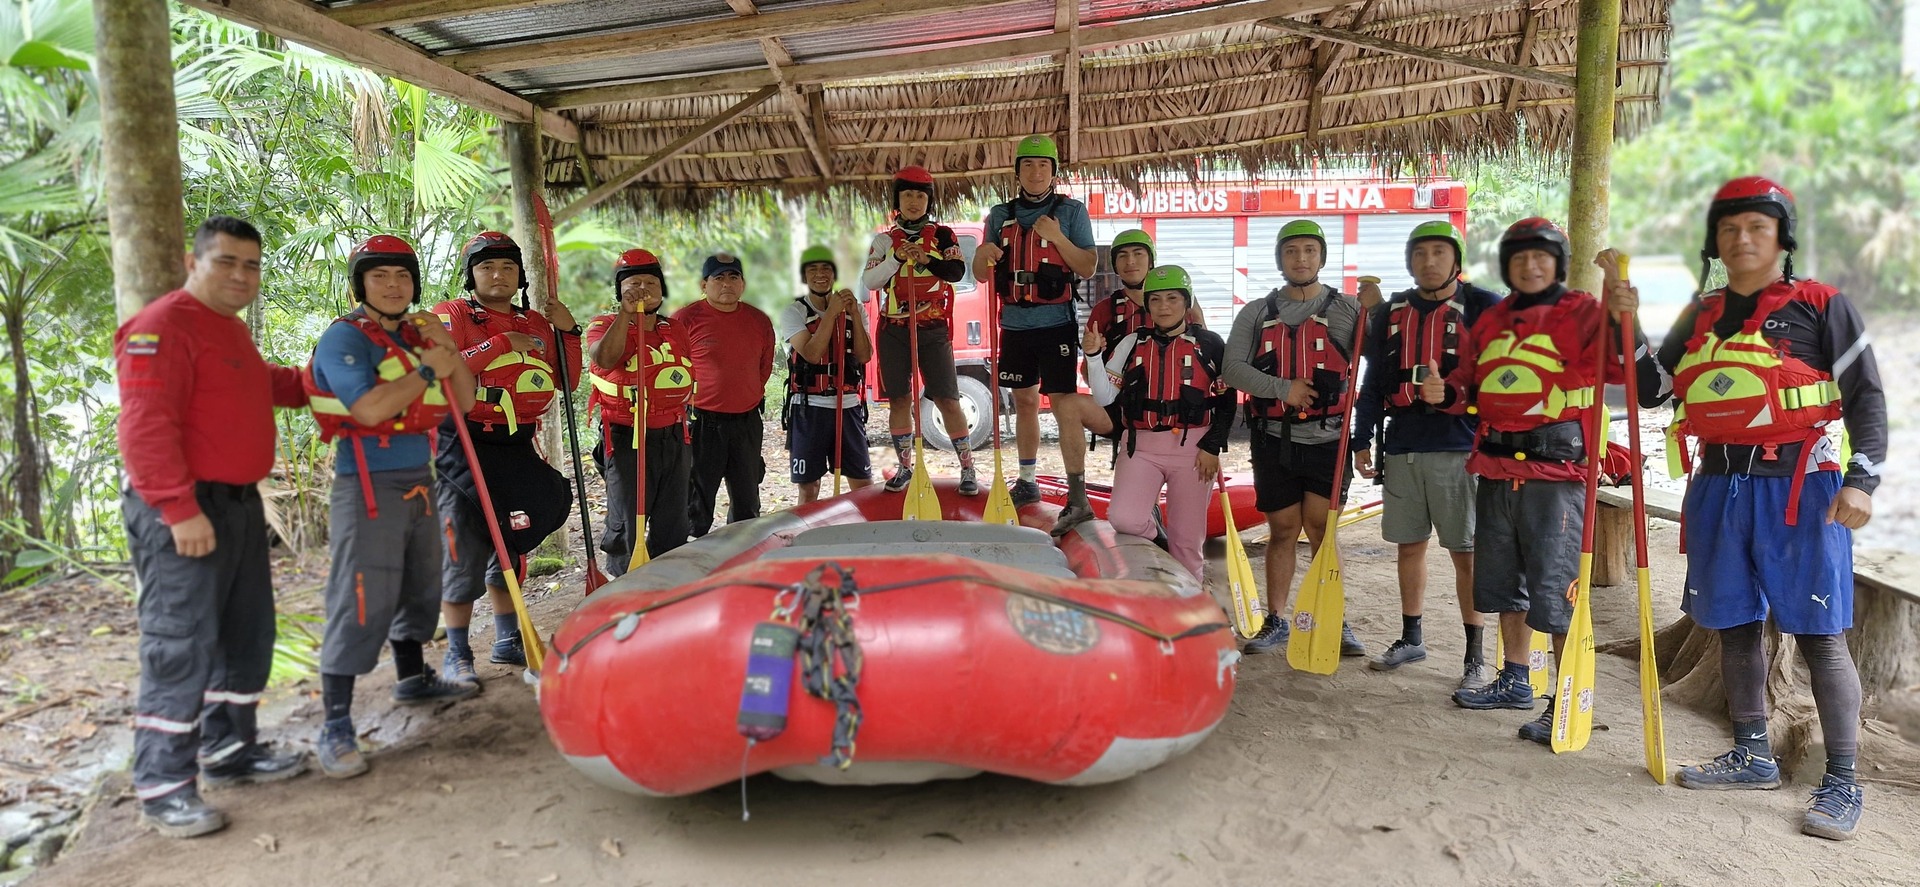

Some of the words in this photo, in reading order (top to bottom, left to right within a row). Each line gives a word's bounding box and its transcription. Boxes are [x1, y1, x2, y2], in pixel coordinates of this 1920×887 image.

[1104, 190, 1228, 214] BOMBEROS
[1294, 187, 1385, 210] TENA
[792, 458, 806, 475] 20
